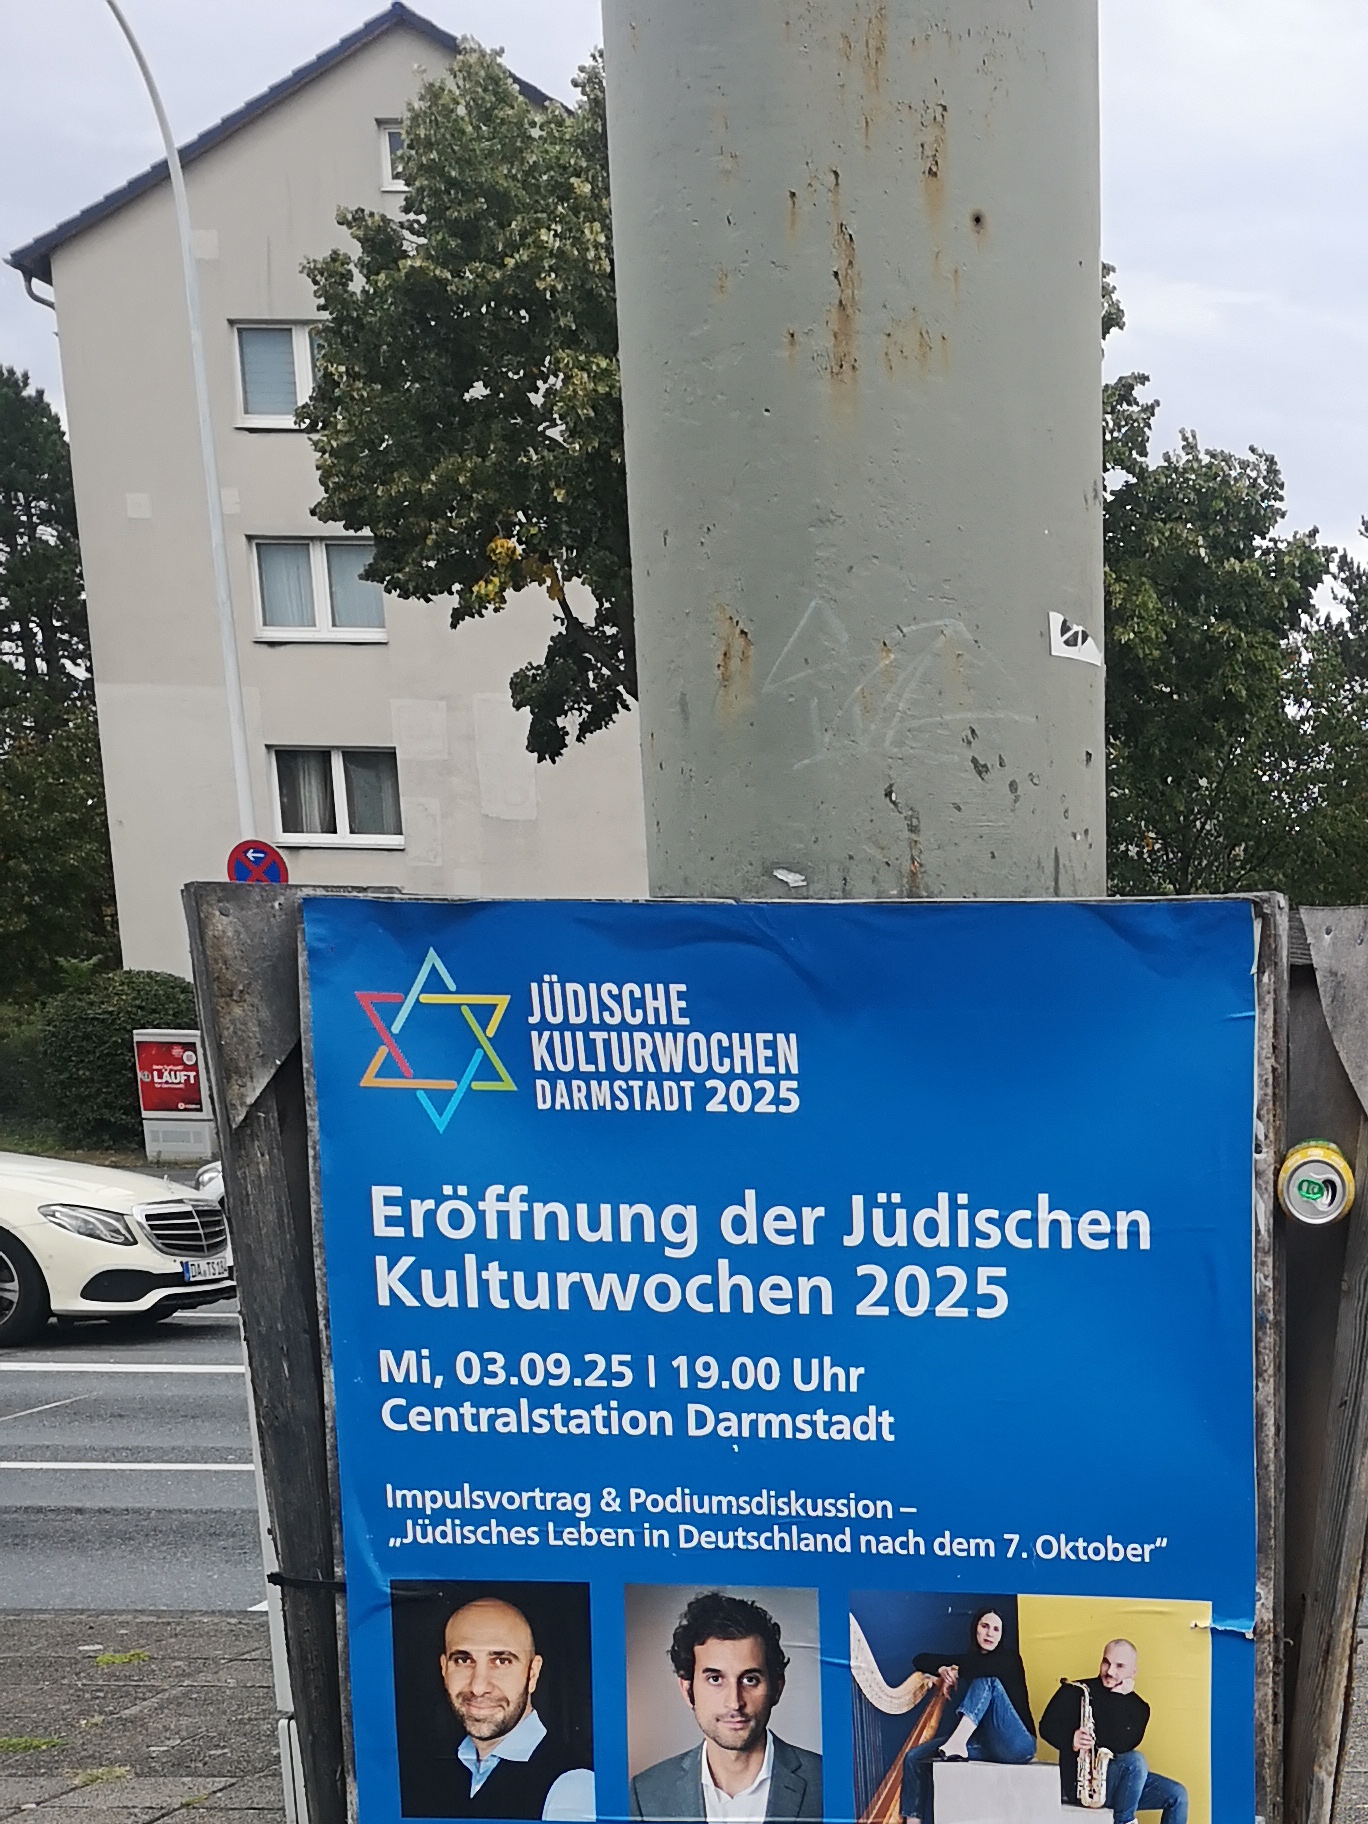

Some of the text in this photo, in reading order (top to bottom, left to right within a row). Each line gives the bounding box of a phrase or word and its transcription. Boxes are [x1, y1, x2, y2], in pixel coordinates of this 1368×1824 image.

[528, 975, 690, 1025] JÜDISCHE
[531, 1031, 798, 1074] KULTURWOCHEN
[153, 1068, 196, 1084] LÄUFT
[536, 1079, 799, 1113] DARMSTADT 2025
[372, 1185, 1151, 1258] Eröffnung der Jüdischen
[376, 1254, 1009, 1319] Kulturwochen 2025
[380, 1349, 443, 1388] Mi,
[456, 1351, 633, 1387] 03.09.25
[672, 1356, 780, 1390] 19.00
[794, 1356, 864, 1392] Uhr
[382, 1398, 894, 1441] Centralstation Darmstadt
[386, 1483, 591, 1518] Impulsvortrag
[600, 1488, 621, 1511] &
[630, 1487, 892, 1518] Podiumsdiskussion
[548, 1521, 634, 1546] Leben
[644, 1523, 669, 1548] in
[679, 1525, 851, 1552] Deutschland
[860, 1529, 925, 1555] nach
[934, 1531, 995, 1557] dem
[1004, 1534, 1027, 1558] 7.
